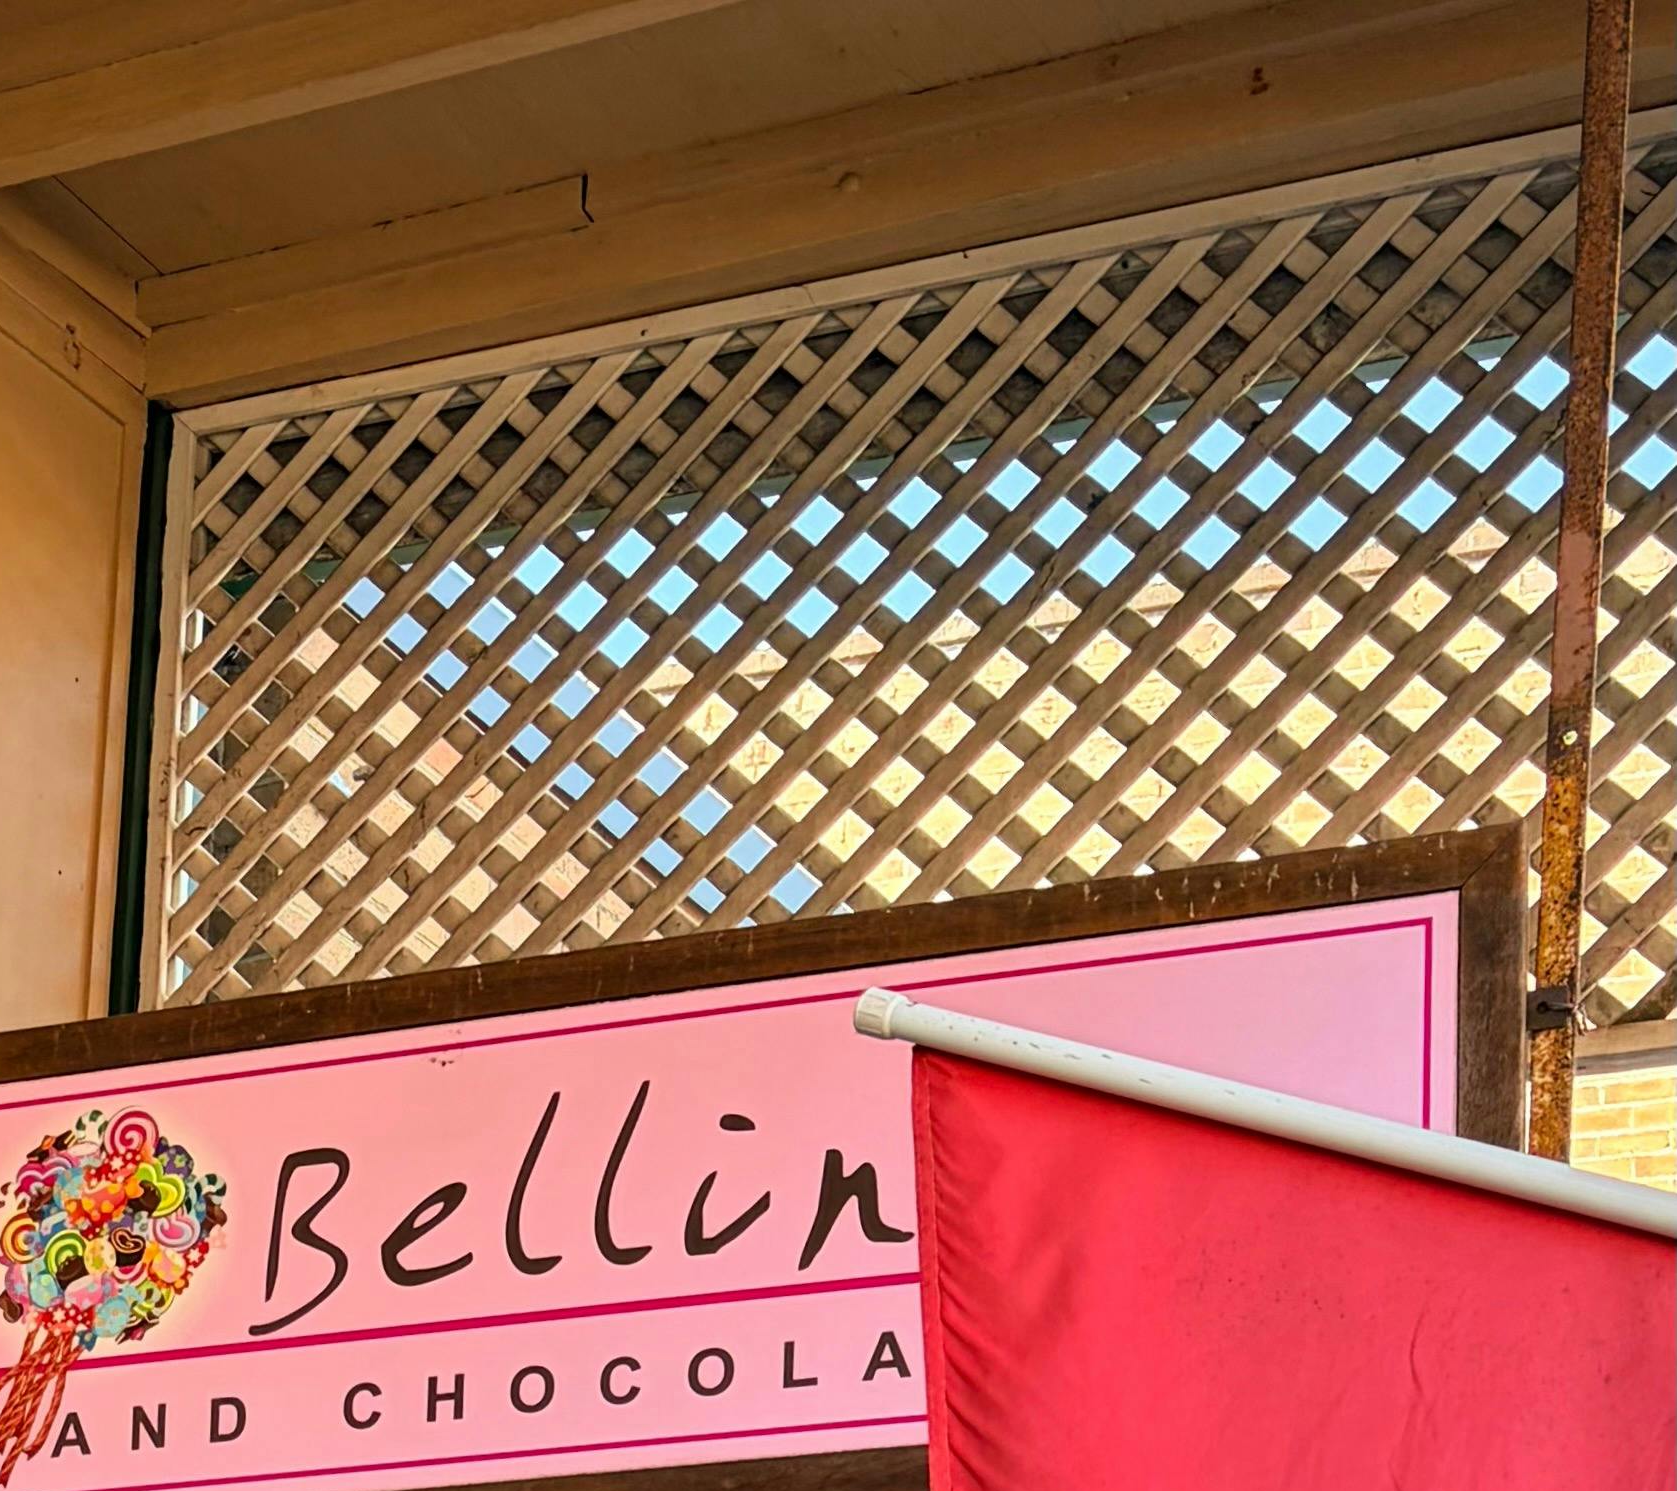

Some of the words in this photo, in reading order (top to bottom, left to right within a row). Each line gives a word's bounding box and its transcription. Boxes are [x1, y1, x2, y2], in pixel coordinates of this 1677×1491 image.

[248, 1079, 915, 1336] Bellin
[50, 1396, 250, 1460] AND
[342, 1330, 912, 1430] CHOCOLA
